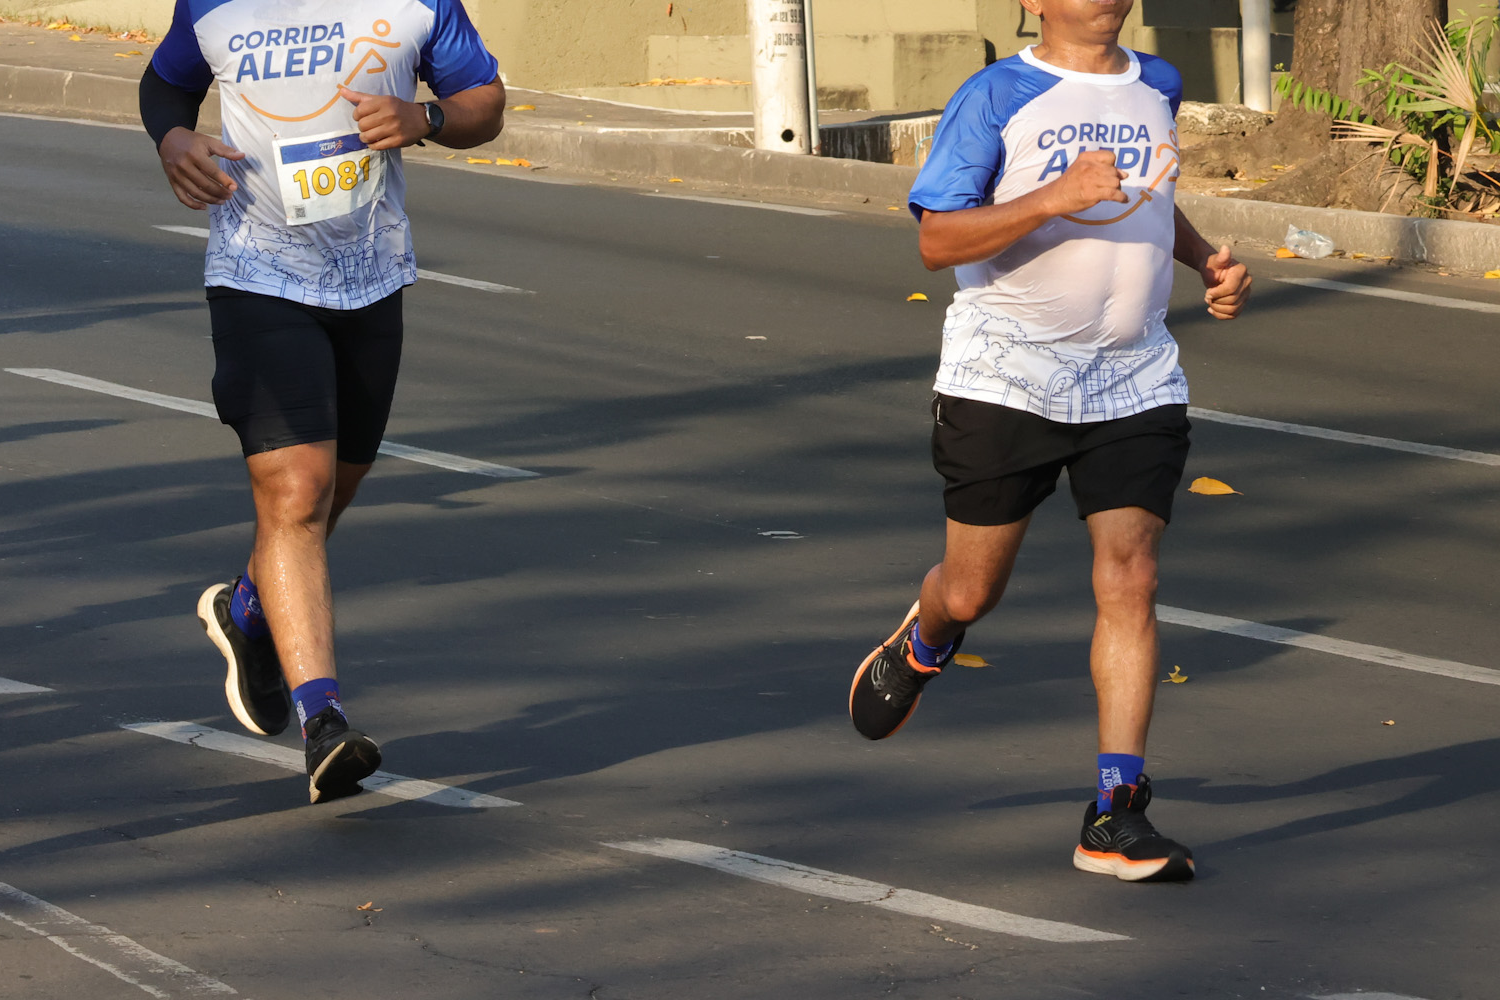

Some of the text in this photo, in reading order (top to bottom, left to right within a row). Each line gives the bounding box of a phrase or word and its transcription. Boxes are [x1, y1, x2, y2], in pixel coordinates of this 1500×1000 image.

[228, 22, 345, 53] CORRIDA
[236, 43, 345, 84] ALEPI
[1037, 122, 1151, 151] CORRIDA
[293, 155, 371, 200] 1081
[1037, 145, 1152, 182] API
[1101, 768, 1114, 791] ALEPI
